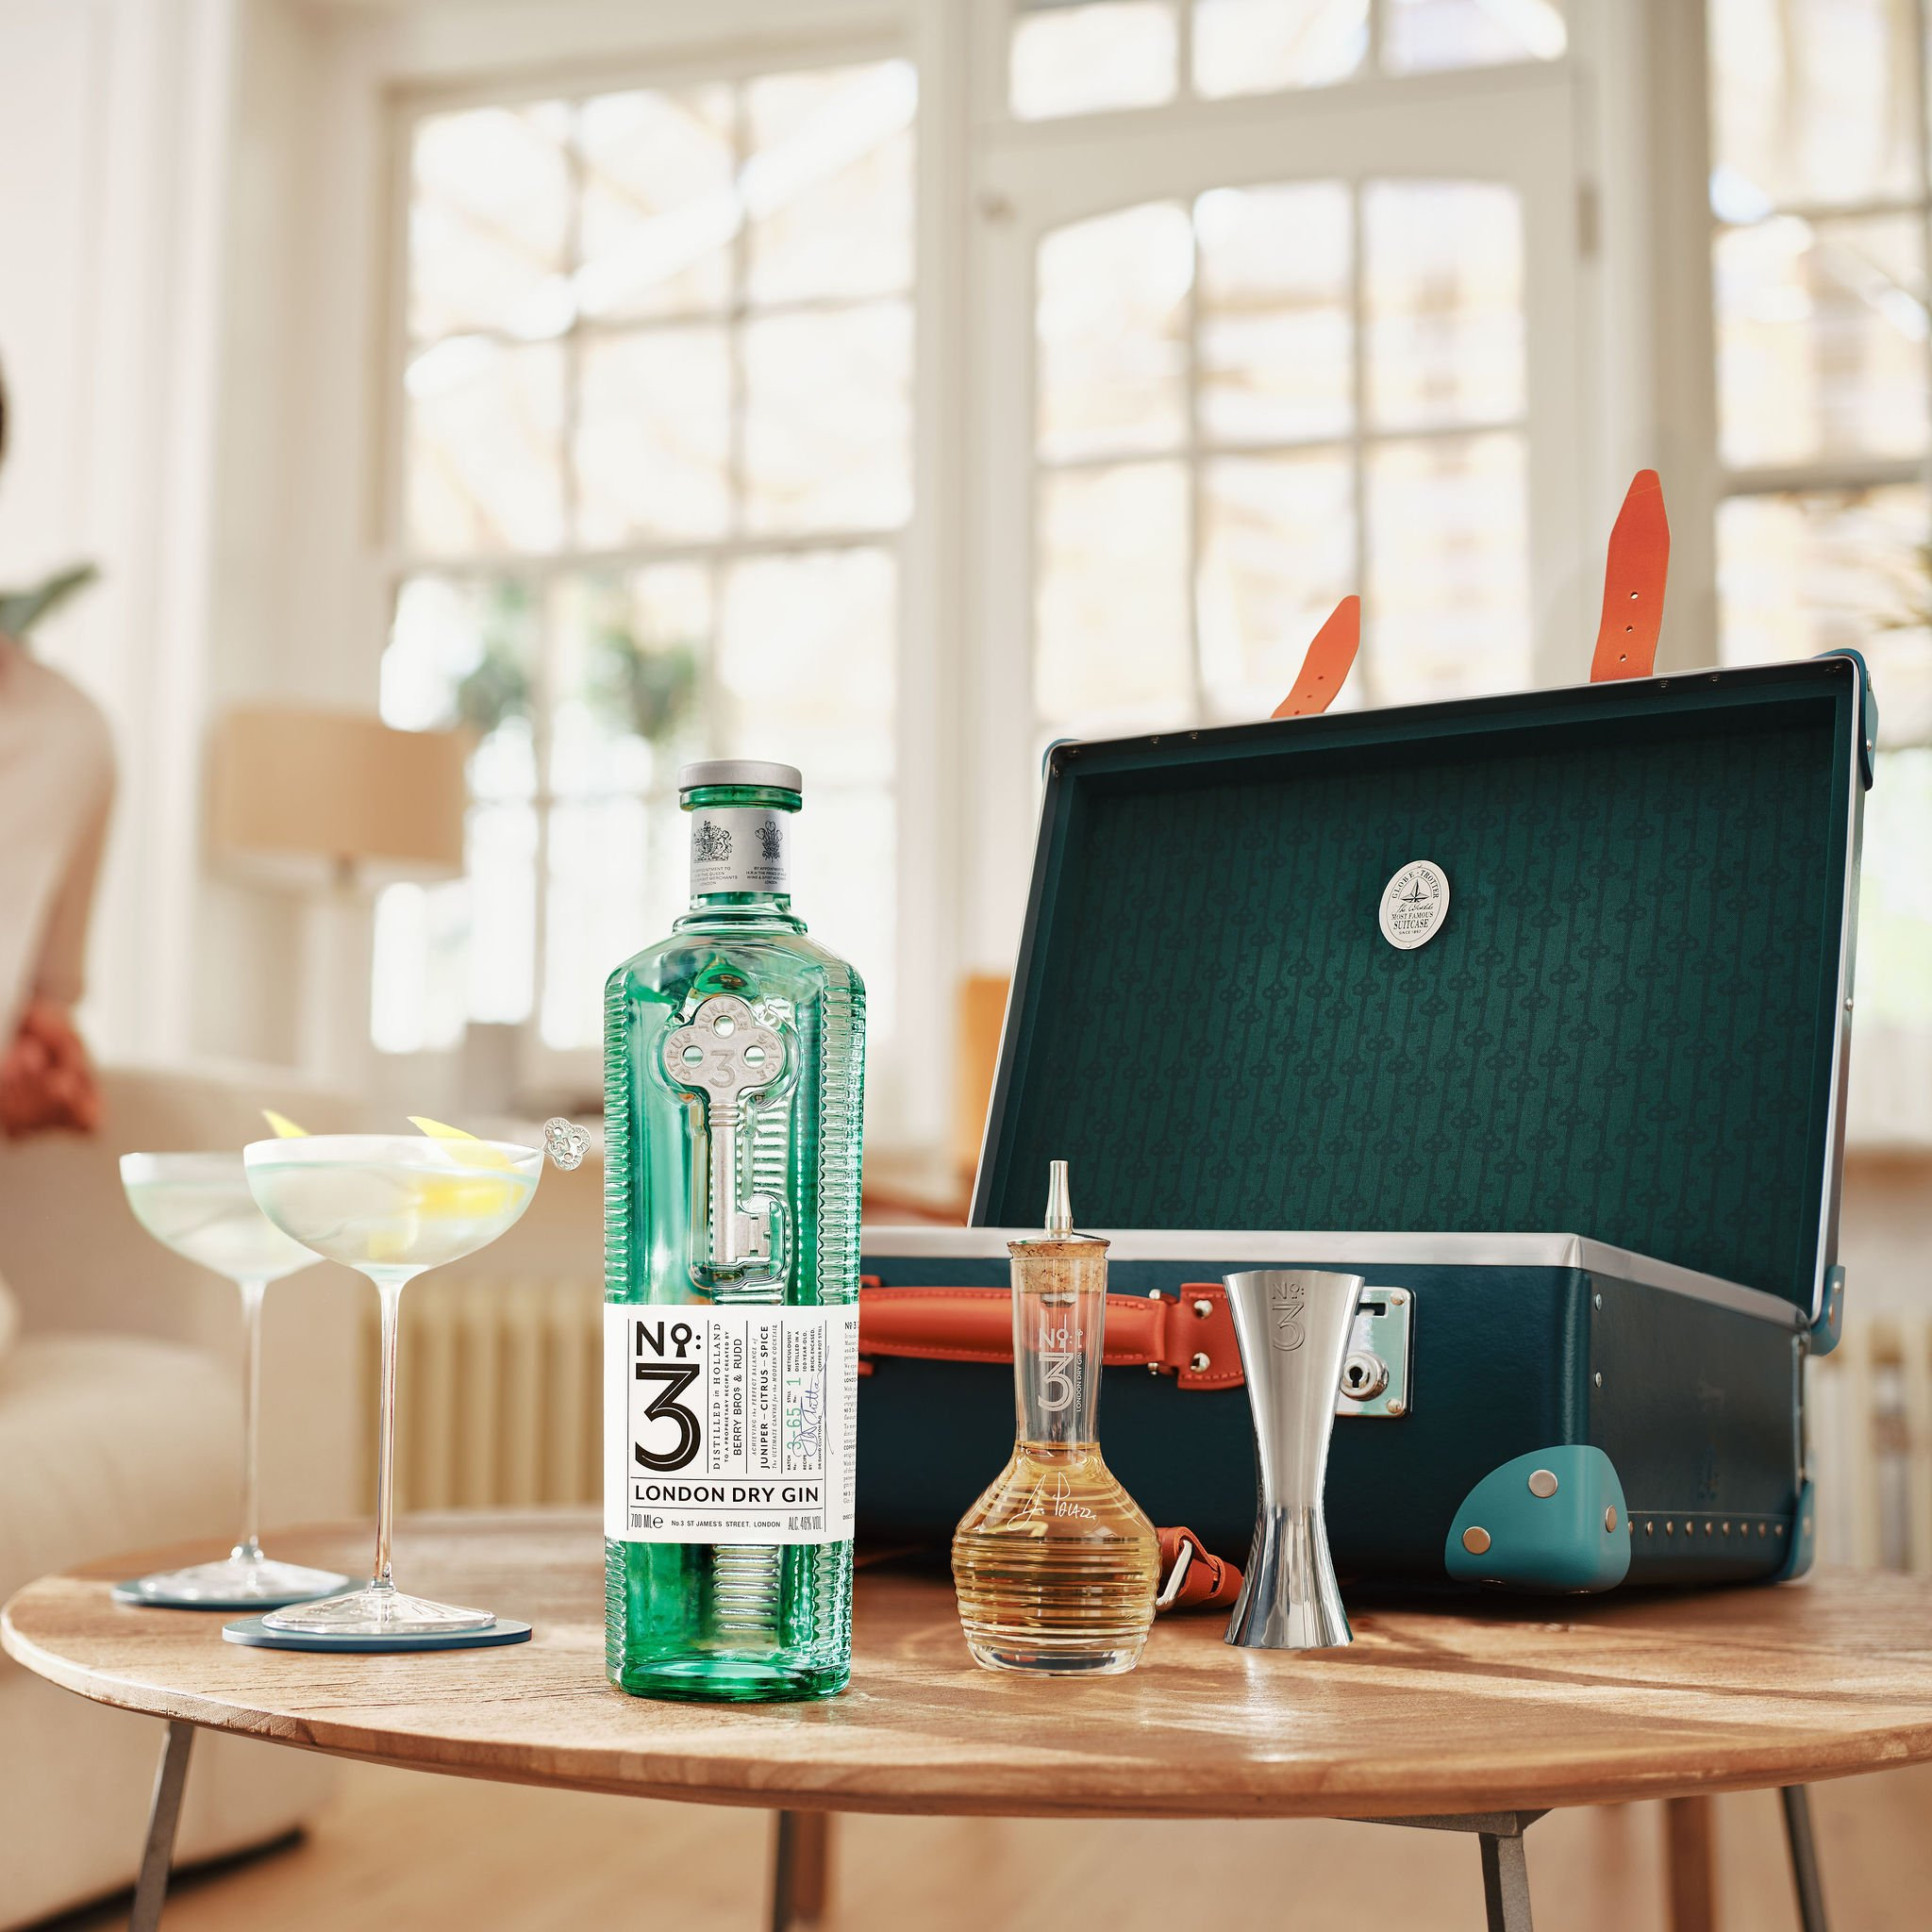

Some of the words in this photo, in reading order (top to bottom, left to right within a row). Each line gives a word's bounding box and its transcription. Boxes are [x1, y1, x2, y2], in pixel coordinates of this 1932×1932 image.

[1393, 919, 1429, 930] SUITCASE
[1407, 911, 1434, 920] FAMOUS
[708, 1048, 737, 1089] 3
[724, 1331, 729, 1340] BY
[760, 1325, 769, 1357] SPICE
[1272, 1302, 1306, 1352] 3
[712, 1324, 721, 1385] HOLLAND
[733, 1339, 742, 1370] RUDD
[733, 1374, 742, 1383] &
[760, 1369, 769, 1410] CITRUS
[786, 1377, 801, 1387] 1
[1038, 1352, 1075, 1412] 3
[635, 1363, 702, 1472] 3
[712, 1402, 721, 1471] DISTILLED
[733, 1419, 742, 1456] BERRY
[760, 1423, 771, 1470] JUNIPER
[724, 1454, 729, 1462] TO
[636, 1485, 724, 1502] LONDON
[732, 1487, 775, 1503] DRY
[781, 1487, 819, 1503] GIN
[631, 1513, 642, 1528] 700
